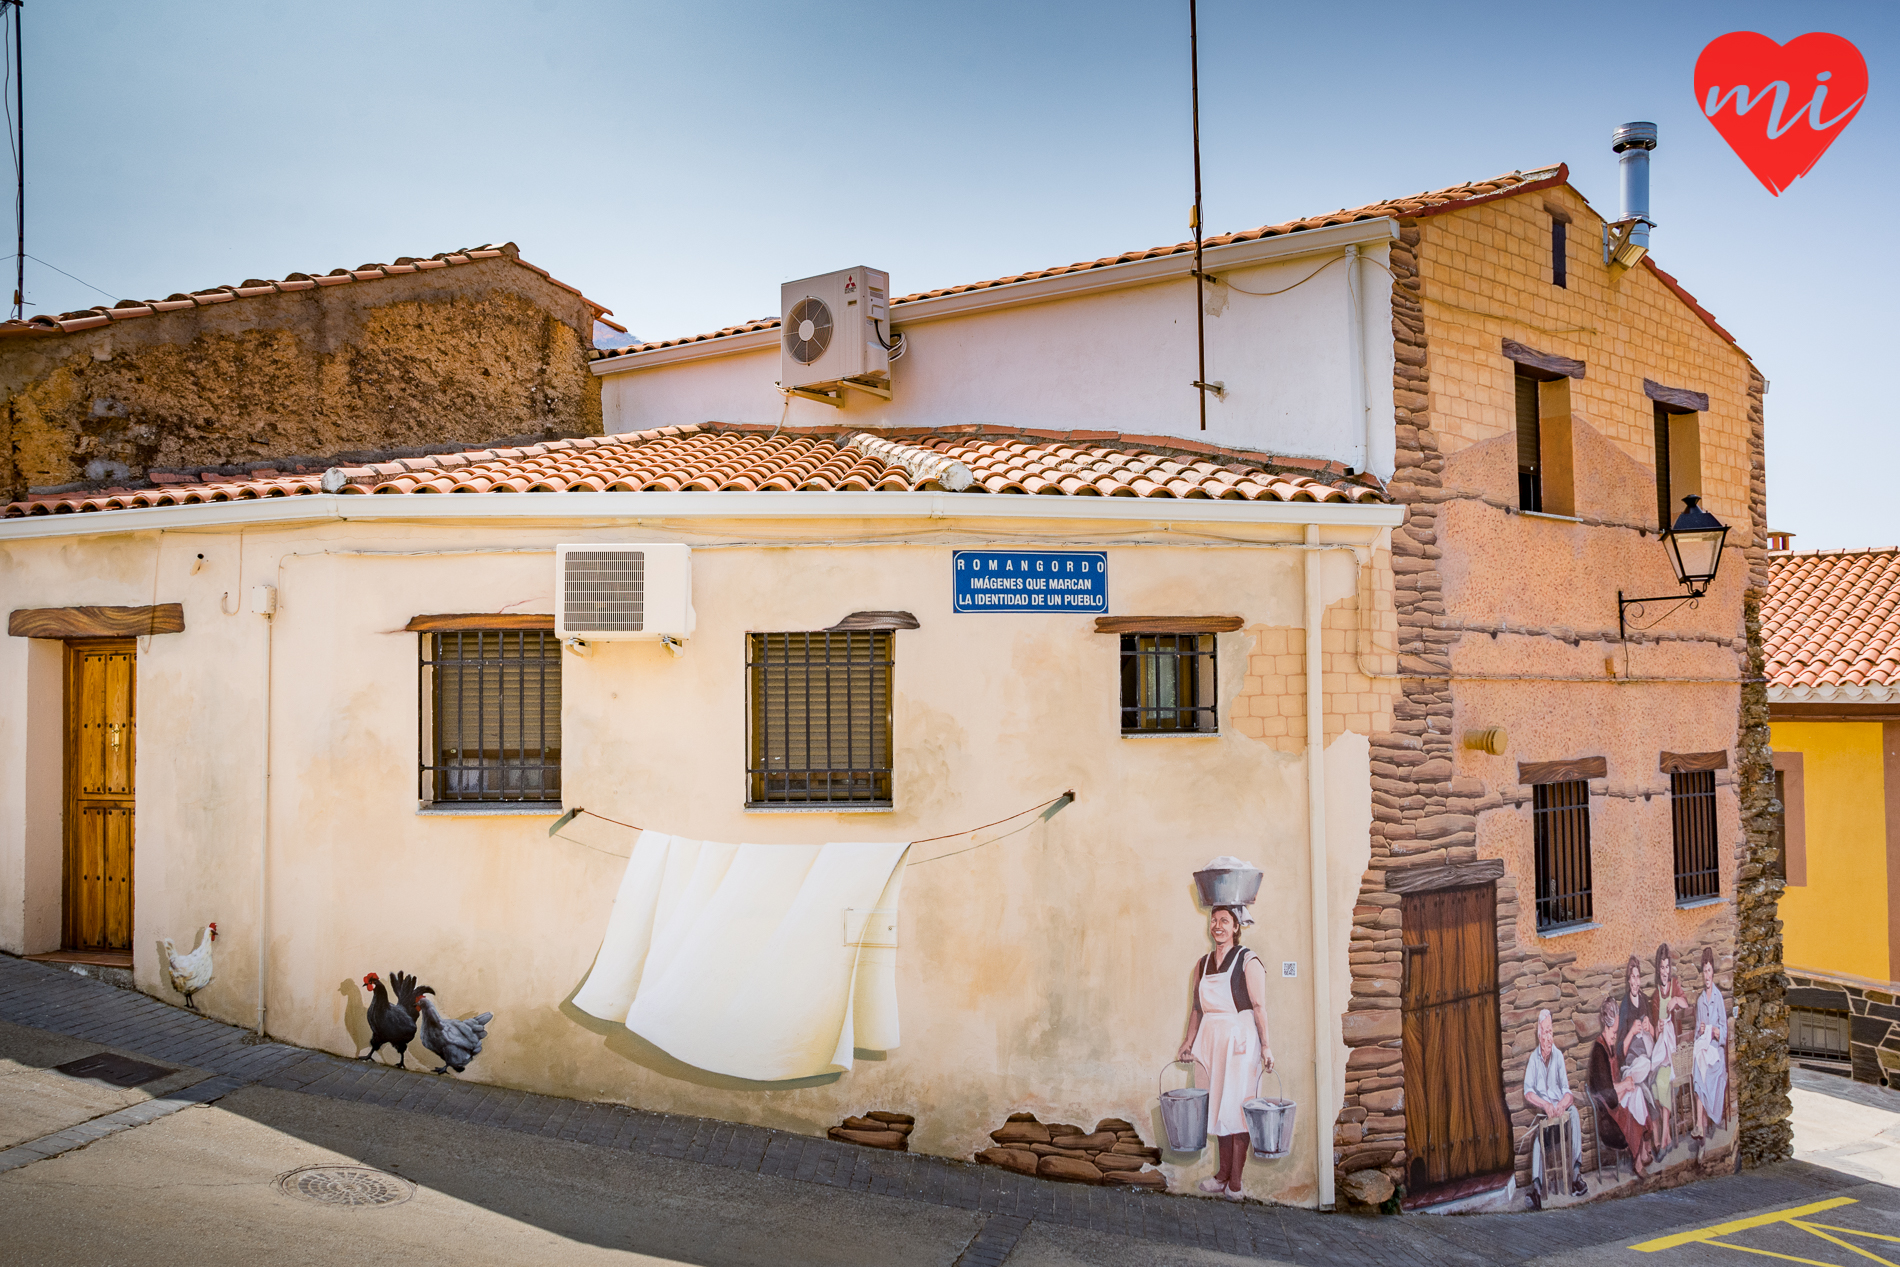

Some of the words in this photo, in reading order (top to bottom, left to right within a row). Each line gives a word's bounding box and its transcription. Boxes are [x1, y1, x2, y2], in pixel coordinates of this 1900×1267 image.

[957, 559, 1105, 573] ROMANGORDO
[970, 575, 1023, 590] IMÁGENES
[1026, 578, 1046, 590] QUE
[1049, 578, 1092, 590] MARCAN
[959, 593, 972, 605] LA
[975, 593, 1029, 605] IDENTIDAD
[1031, 594, 1045, 605] DE
[1047, 594, 1062, 605] UN
[1064, 594, 1103, 606] PUEBLO
